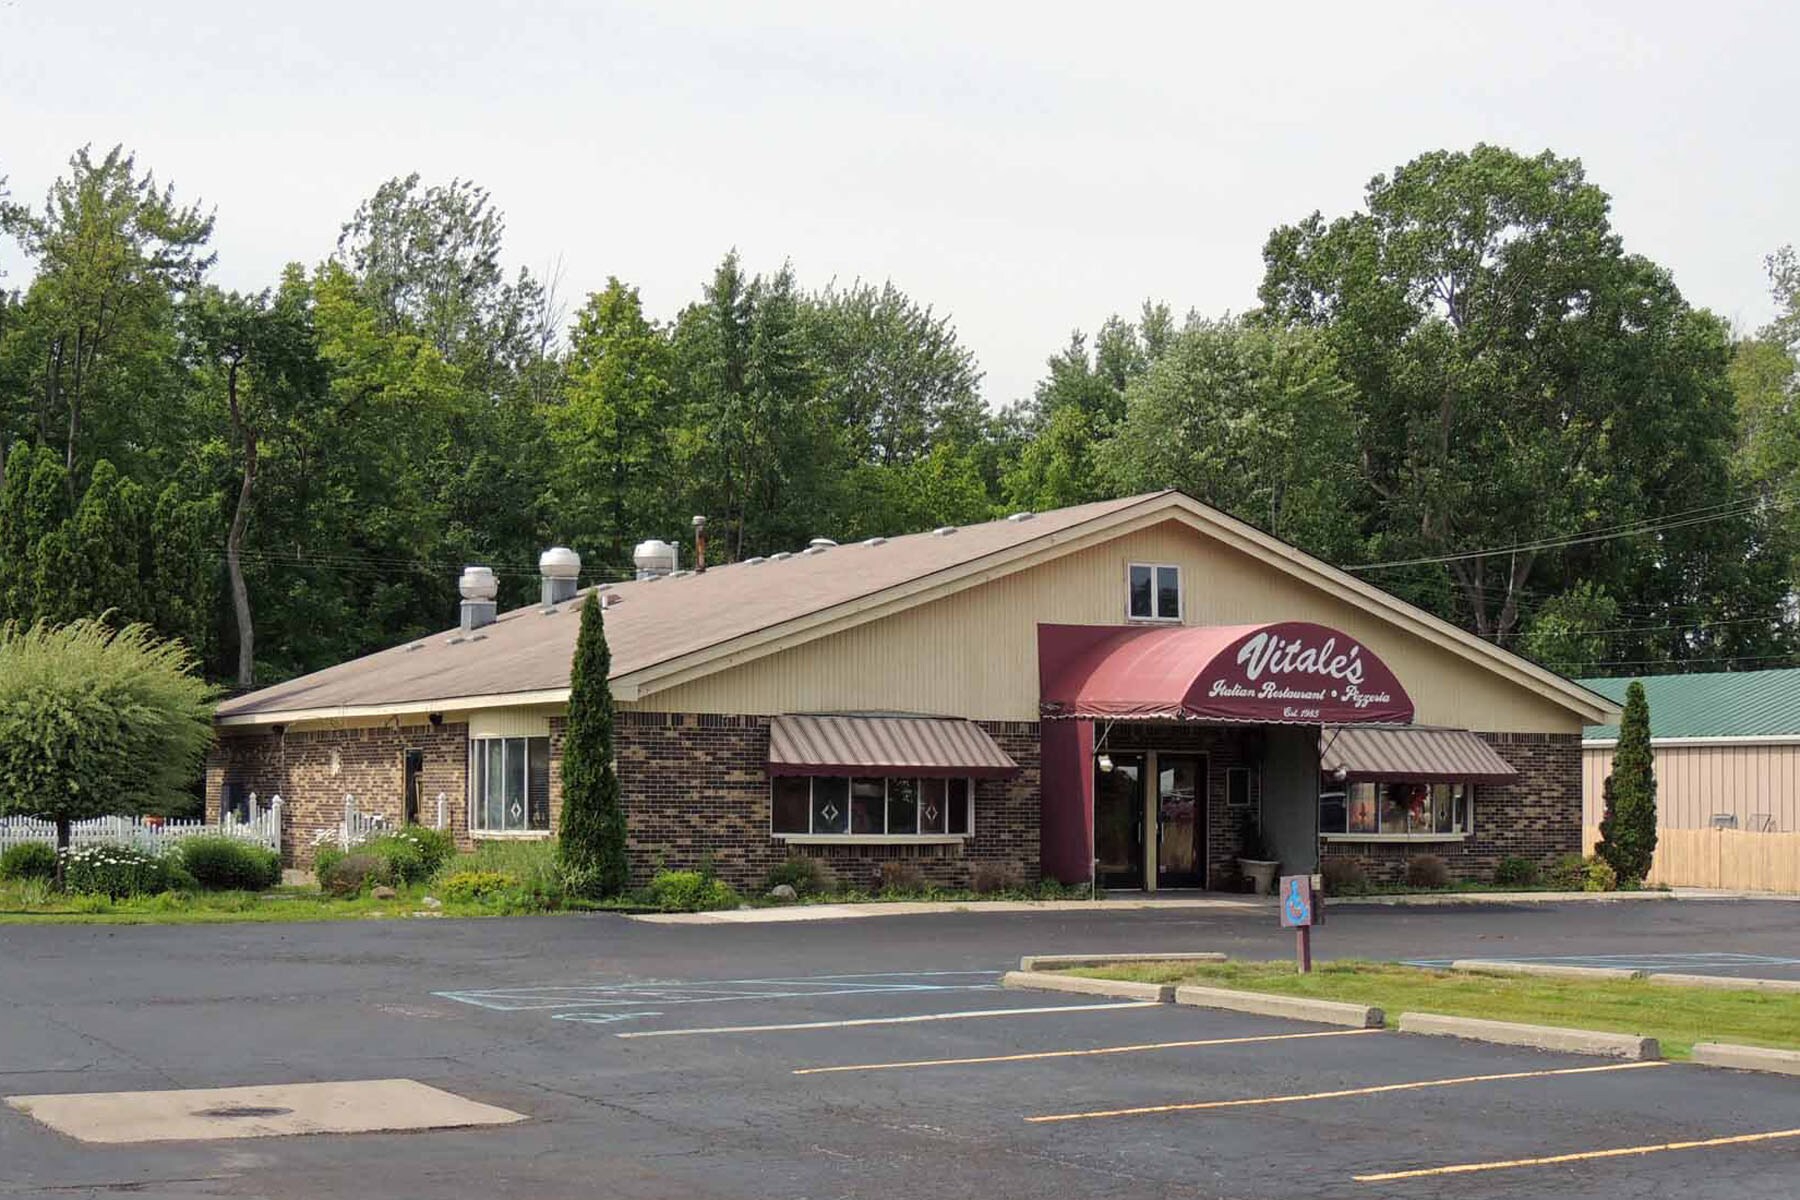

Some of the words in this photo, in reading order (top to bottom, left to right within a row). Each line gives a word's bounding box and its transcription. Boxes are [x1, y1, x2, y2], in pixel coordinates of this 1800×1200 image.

[1237, 632, 1364, 684] Vitale's
[1208, 679, 1256, 698] Italian
[1258, 681, 1326, 700] Restaurant
[1341, 685, 1390, 708] Pizzeria
